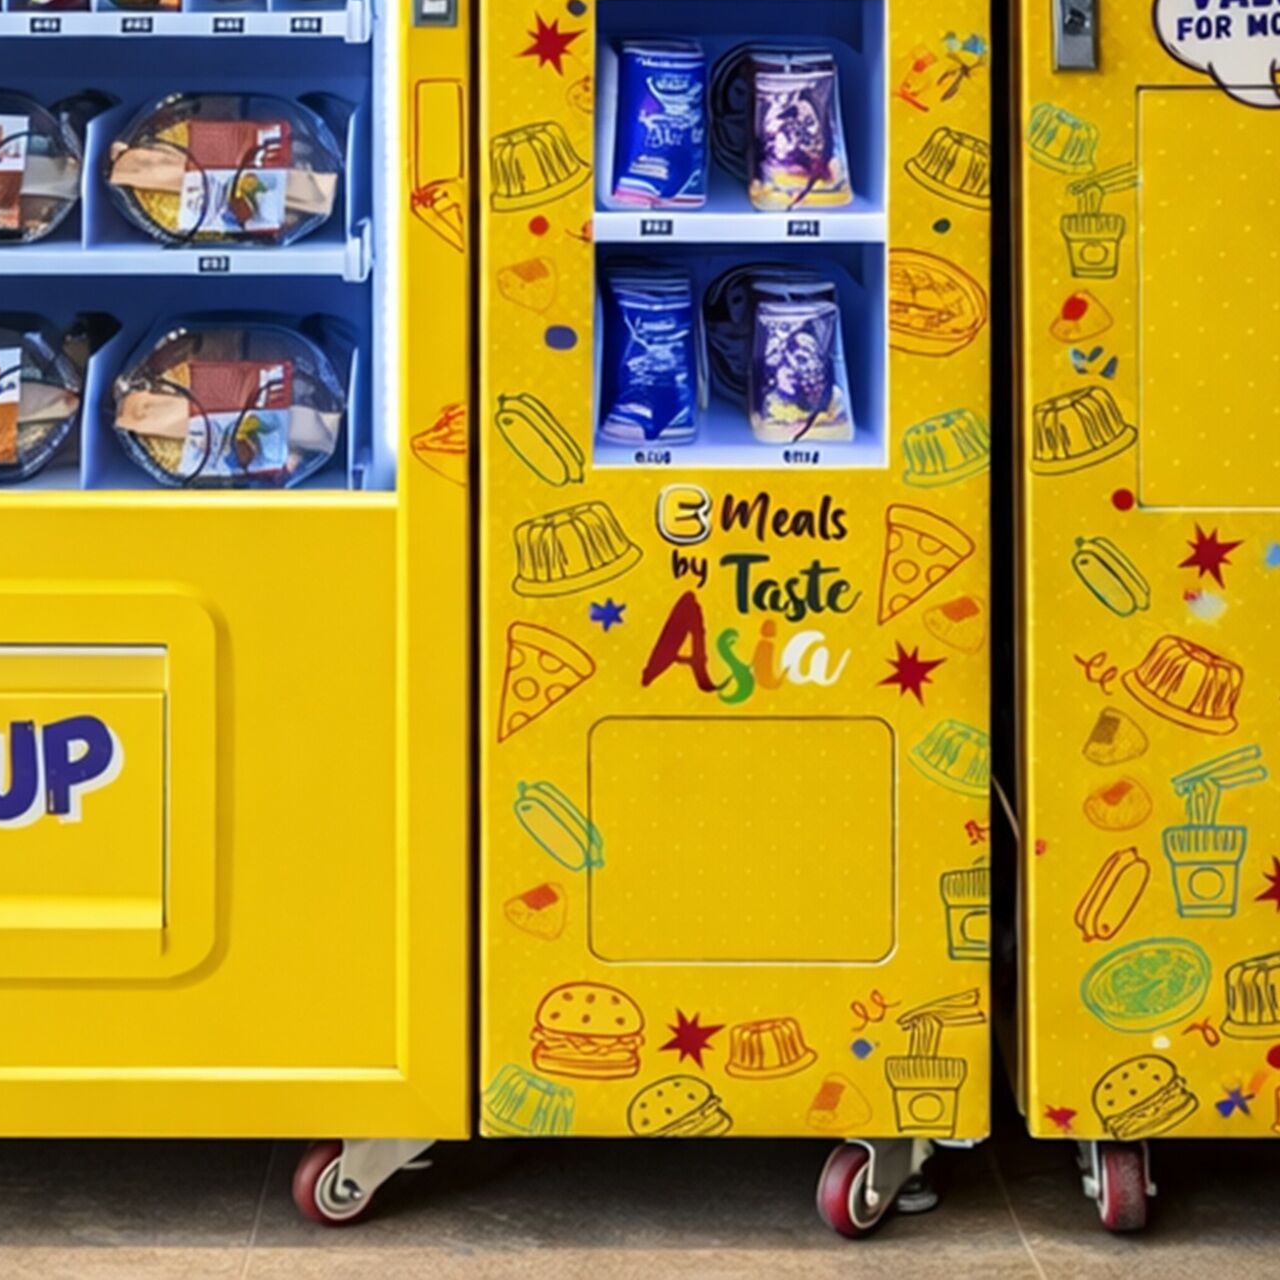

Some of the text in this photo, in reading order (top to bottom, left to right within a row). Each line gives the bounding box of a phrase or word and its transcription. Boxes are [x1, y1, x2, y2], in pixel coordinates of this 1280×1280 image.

[1177, 15, 1232, 41] FOR
[656, 483, 848, 546] E Meals
[672, 550, 862, 623] by Taste
[641, 590, 851, 704] Asia
